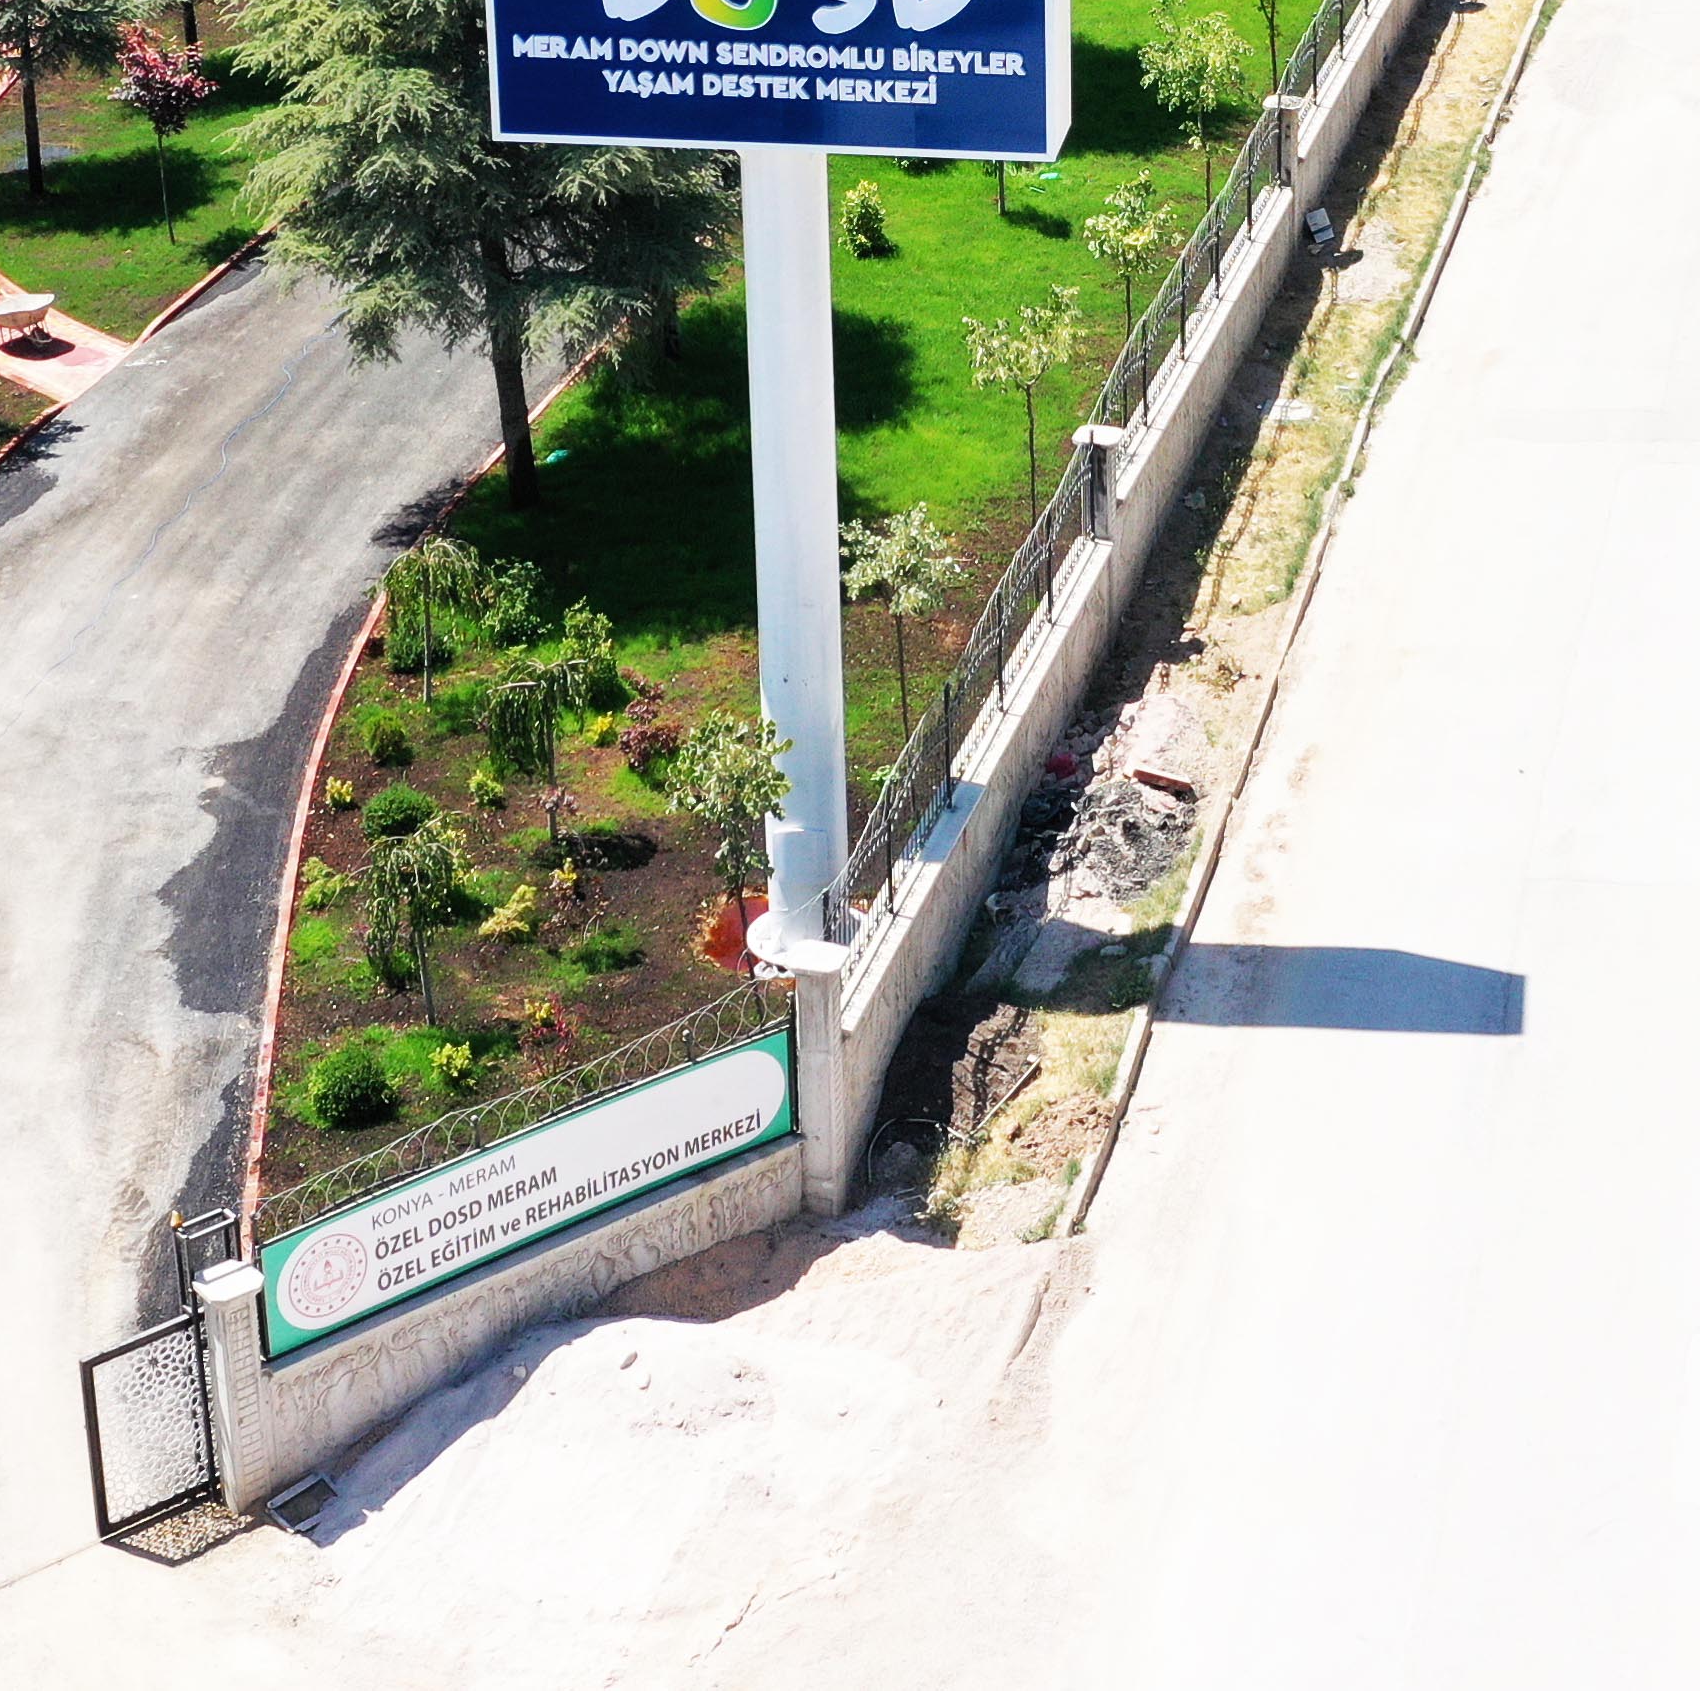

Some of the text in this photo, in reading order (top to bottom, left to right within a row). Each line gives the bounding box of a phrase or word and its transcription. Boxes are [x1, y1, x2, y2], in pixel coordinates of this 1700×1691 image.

[512, 34, 1026, 76] MERAM DOWN SENDROMLU BİREYLER
[601, 69, 938, 105] YAŞAM DESTEK MERKEZİ
[371, 1192, 434, 1231] KONYA
[450, 1155, 516, 1198] MERAM
[375, 1166, 558, 1261] ÖZEL DOSD MERAM
[377, 1257, 427, 1292] ÖZEL
[431, 1224, 496, 1269] EĞİTİM
[500, 1217, 522, 1237] ve
[525, 1148, 680, 1227] REHABİLİTASYON
[684, 1107, 762, 1159] MERKEZİ
